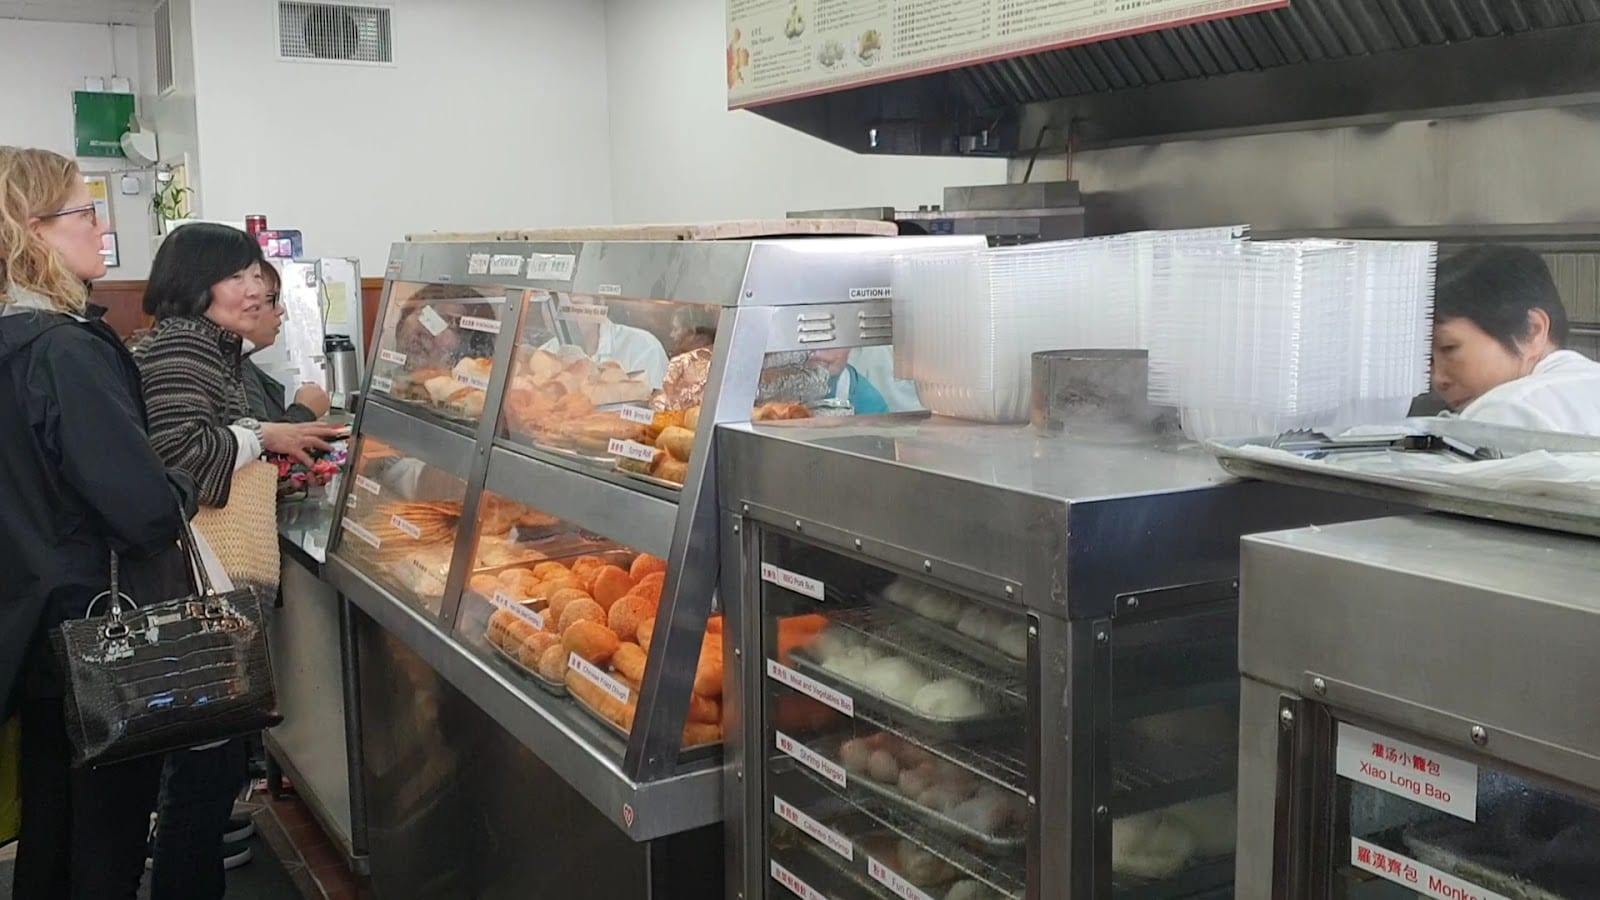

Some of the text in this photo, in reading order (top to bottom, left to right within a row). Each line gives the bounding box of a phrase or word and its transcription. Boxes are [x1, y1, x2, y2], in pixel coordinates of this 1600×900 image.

[851, 289, 883, 297] CAUTION
[799, 748, 820, 769] Shrimp
[1360, 760, 1451, 803] Xiao Long Bao
